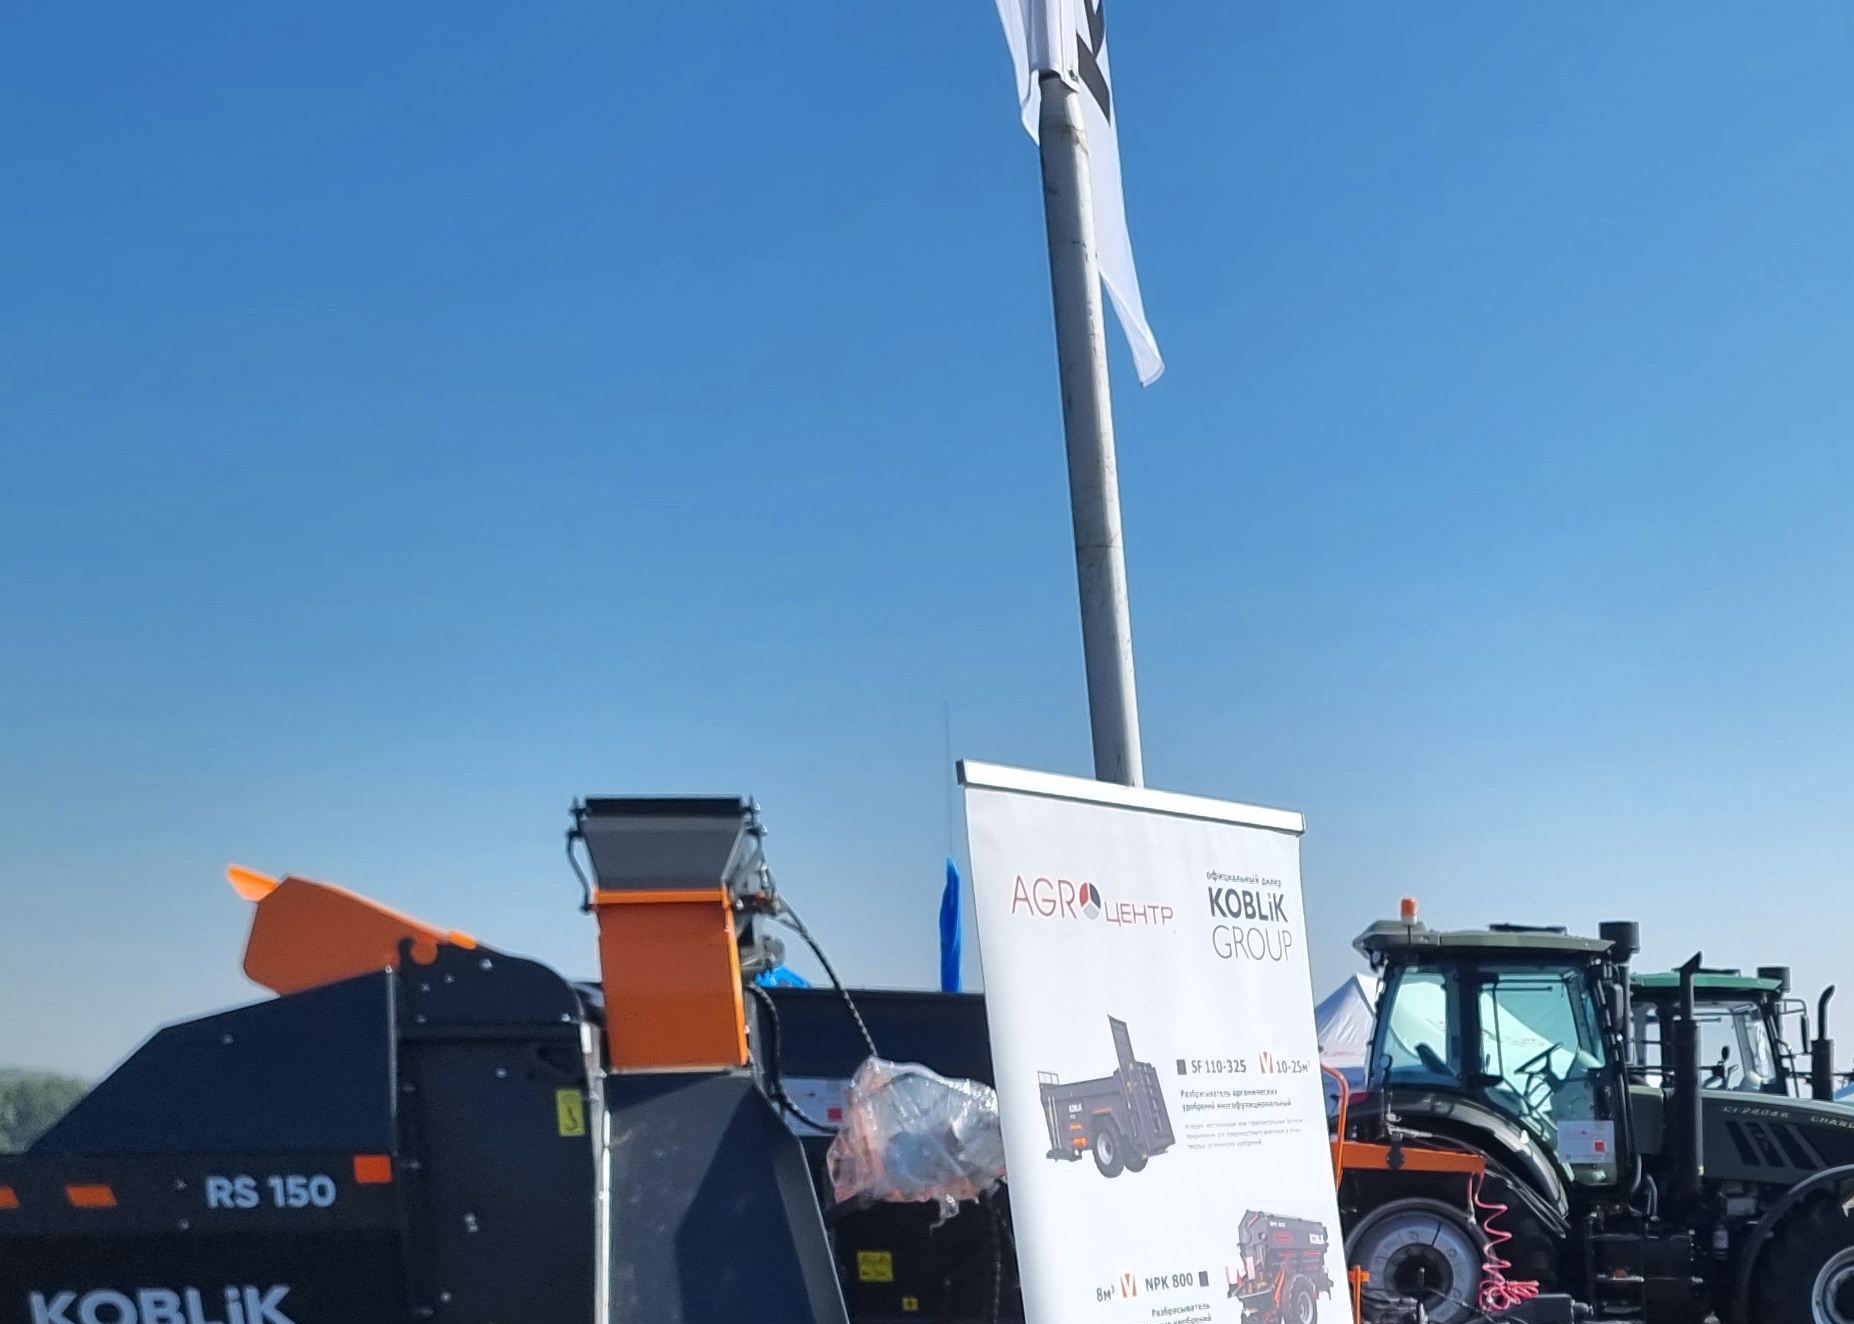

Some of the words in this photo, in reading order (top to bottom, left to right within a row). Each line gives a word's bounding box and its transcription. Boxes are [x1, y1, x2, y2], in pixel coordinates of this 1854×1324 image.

[1212, 924, 1293, 961] GROUP
[1191, 1059, 1203, 1074] SF
[1205, 1059, 1247, 1074] 110-325
[205, 1174, 260, 1209] RS
[267, 1173, 338, 1209] 150
[1145, 1275, 1170, 1292] NPK
[1172, 1272, 1194, 1289] 800
